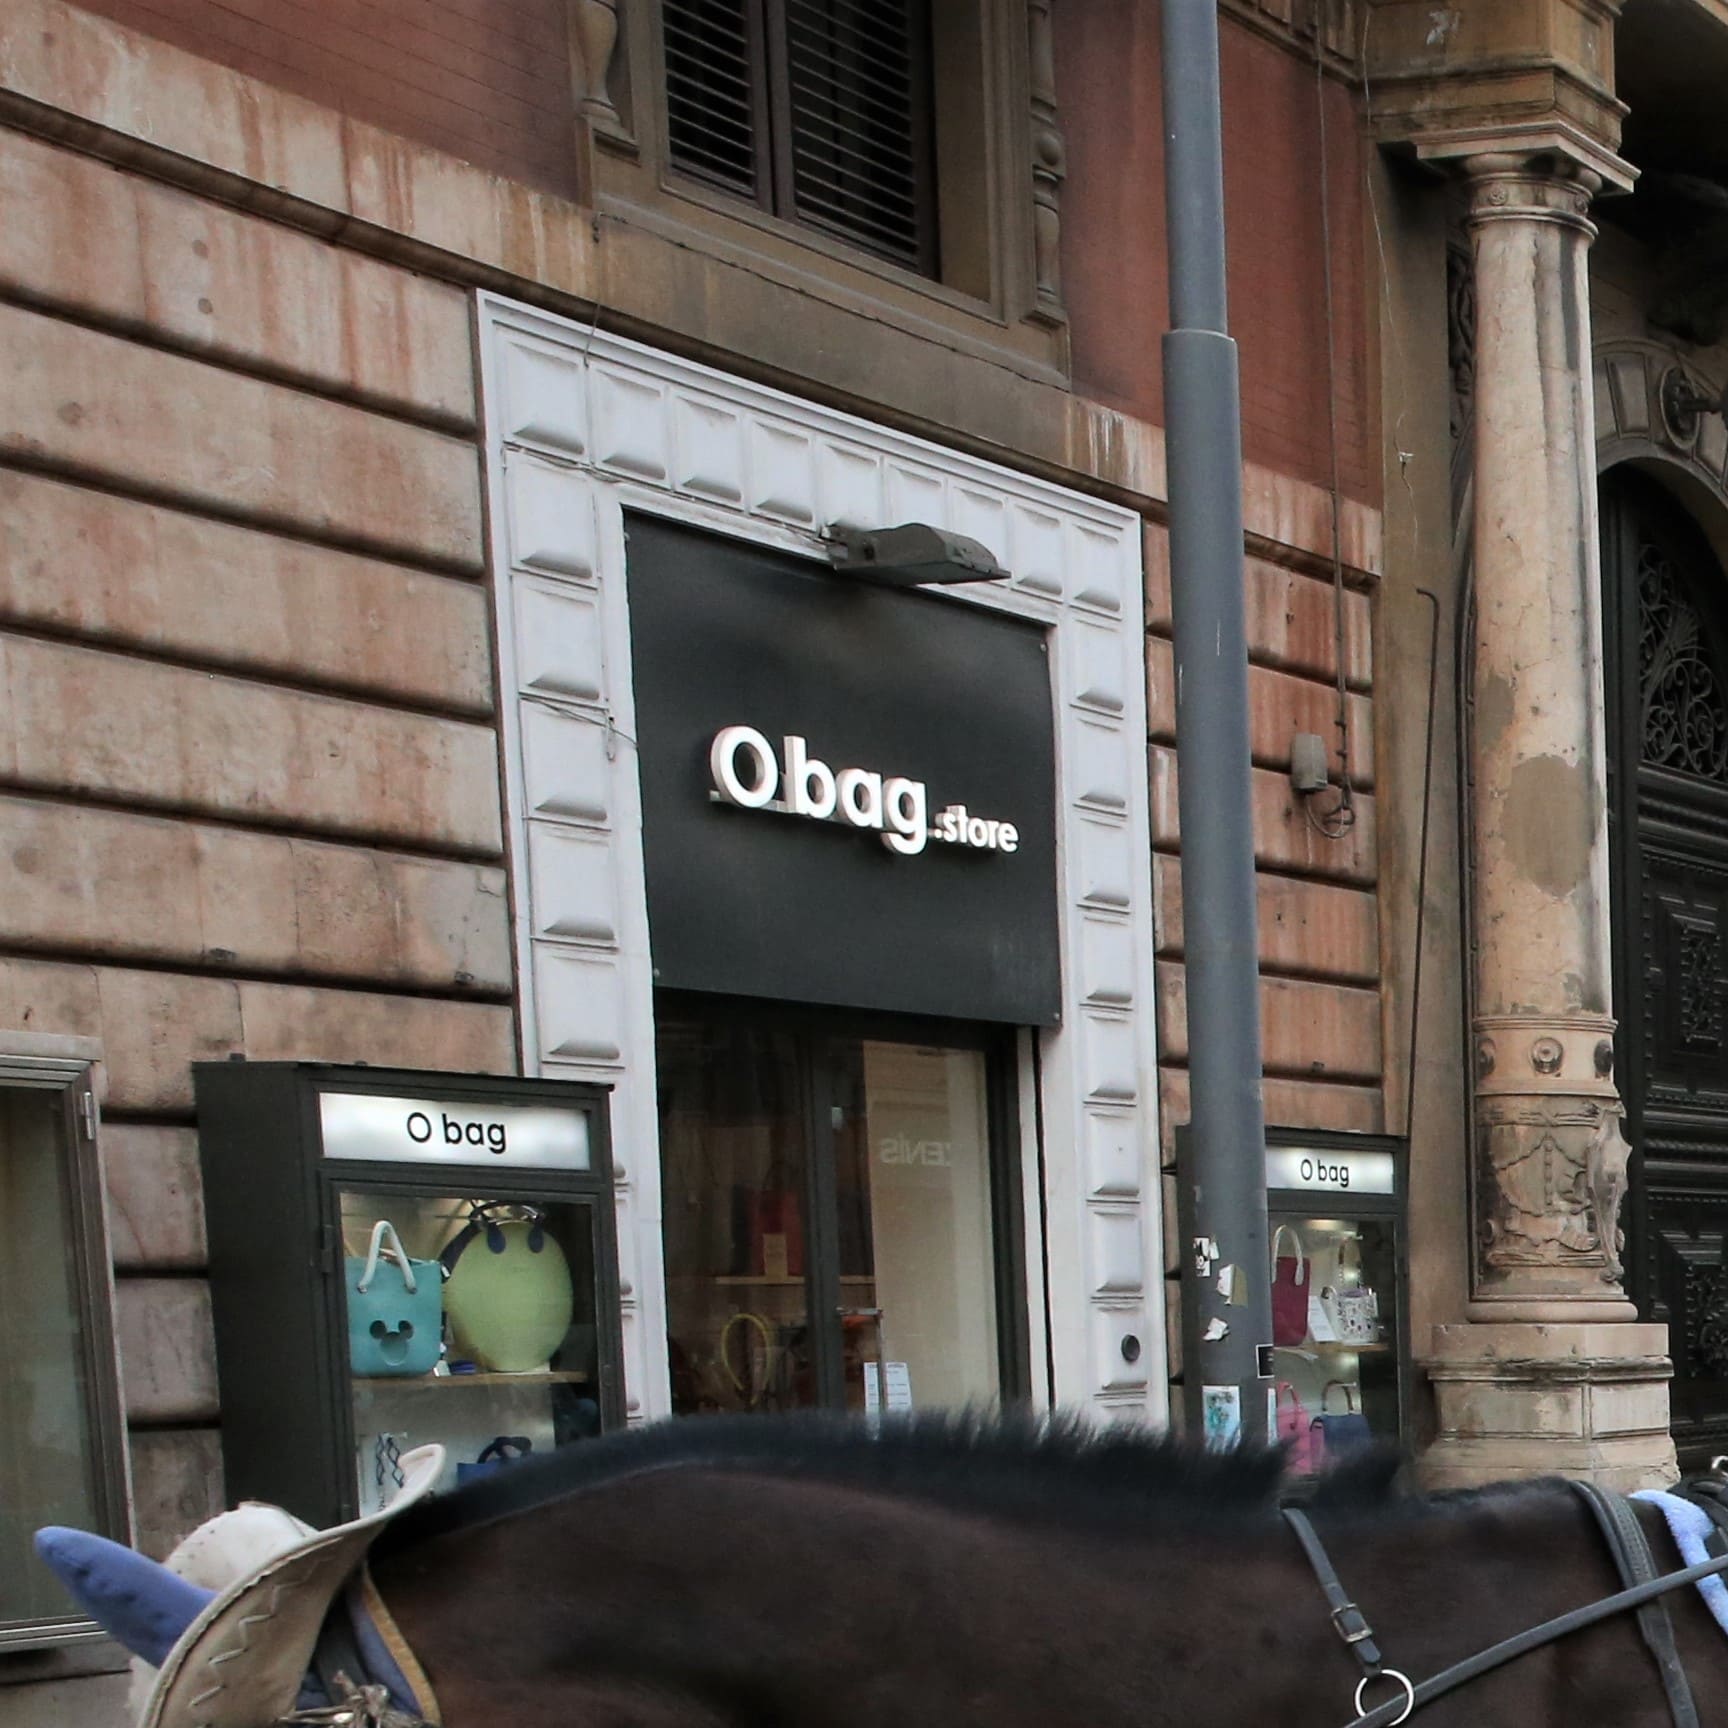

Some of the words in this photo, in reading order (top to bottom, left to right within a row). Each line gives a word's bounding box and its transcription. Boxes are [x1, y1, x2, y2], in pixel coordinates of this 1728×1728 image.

[711, 725, 778, 808] O
[783, 735, 927, 855] bag
[934, 804, 1019, 852] .store
[407, 1112, 432, 1143] O
[442, 1113, 506, 1154] bag
[1301, 1159, 1313, 1181] O
[1318, 1160, 1349, 1188] bag
